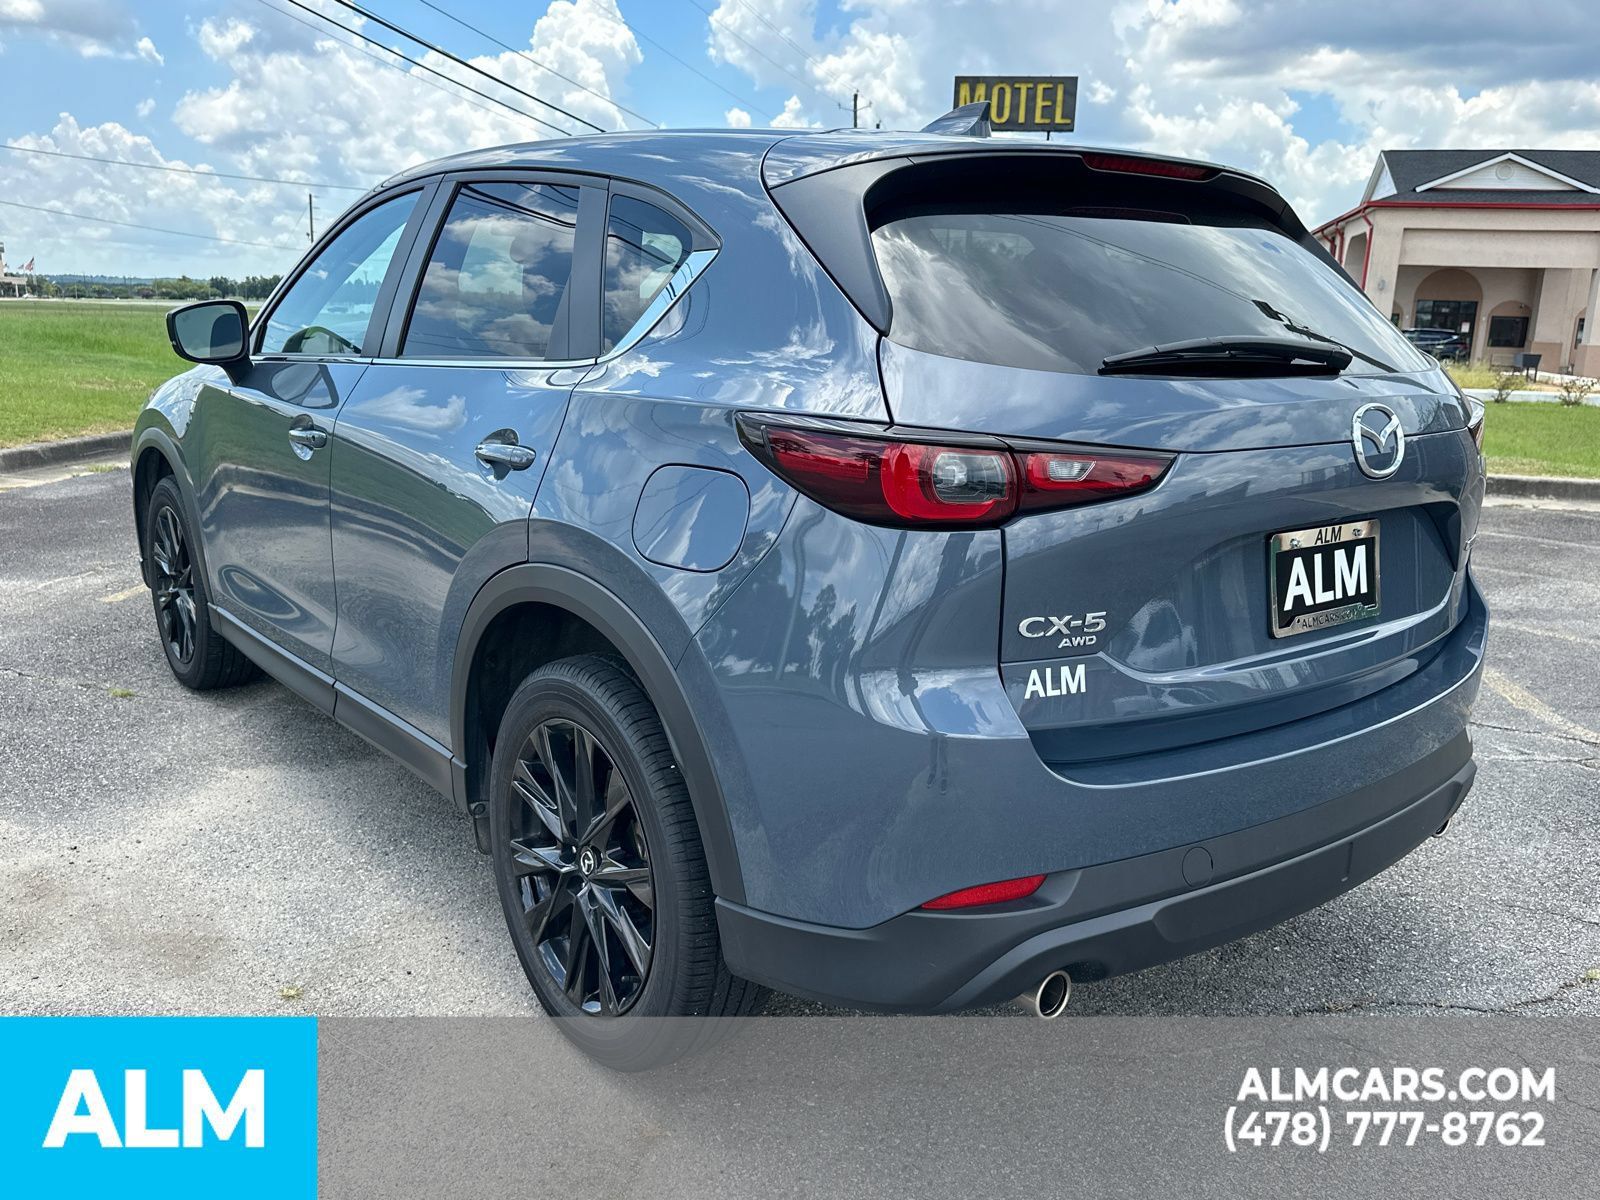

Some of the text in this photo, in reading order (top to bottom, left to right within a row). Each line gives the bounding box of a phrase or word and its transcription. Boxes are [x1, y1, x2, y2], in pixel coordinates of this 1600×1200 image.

[958, 82, 1071, 124] MOTEL
[1314, 526, 1342, 545] ALM
[1283, 544, 1368, 612] ALM
[1018, 611, 1107, 638] CX-5
[1057, 635, 1097, 649] AWD
[1024, 663, 1086, 700] ALM
